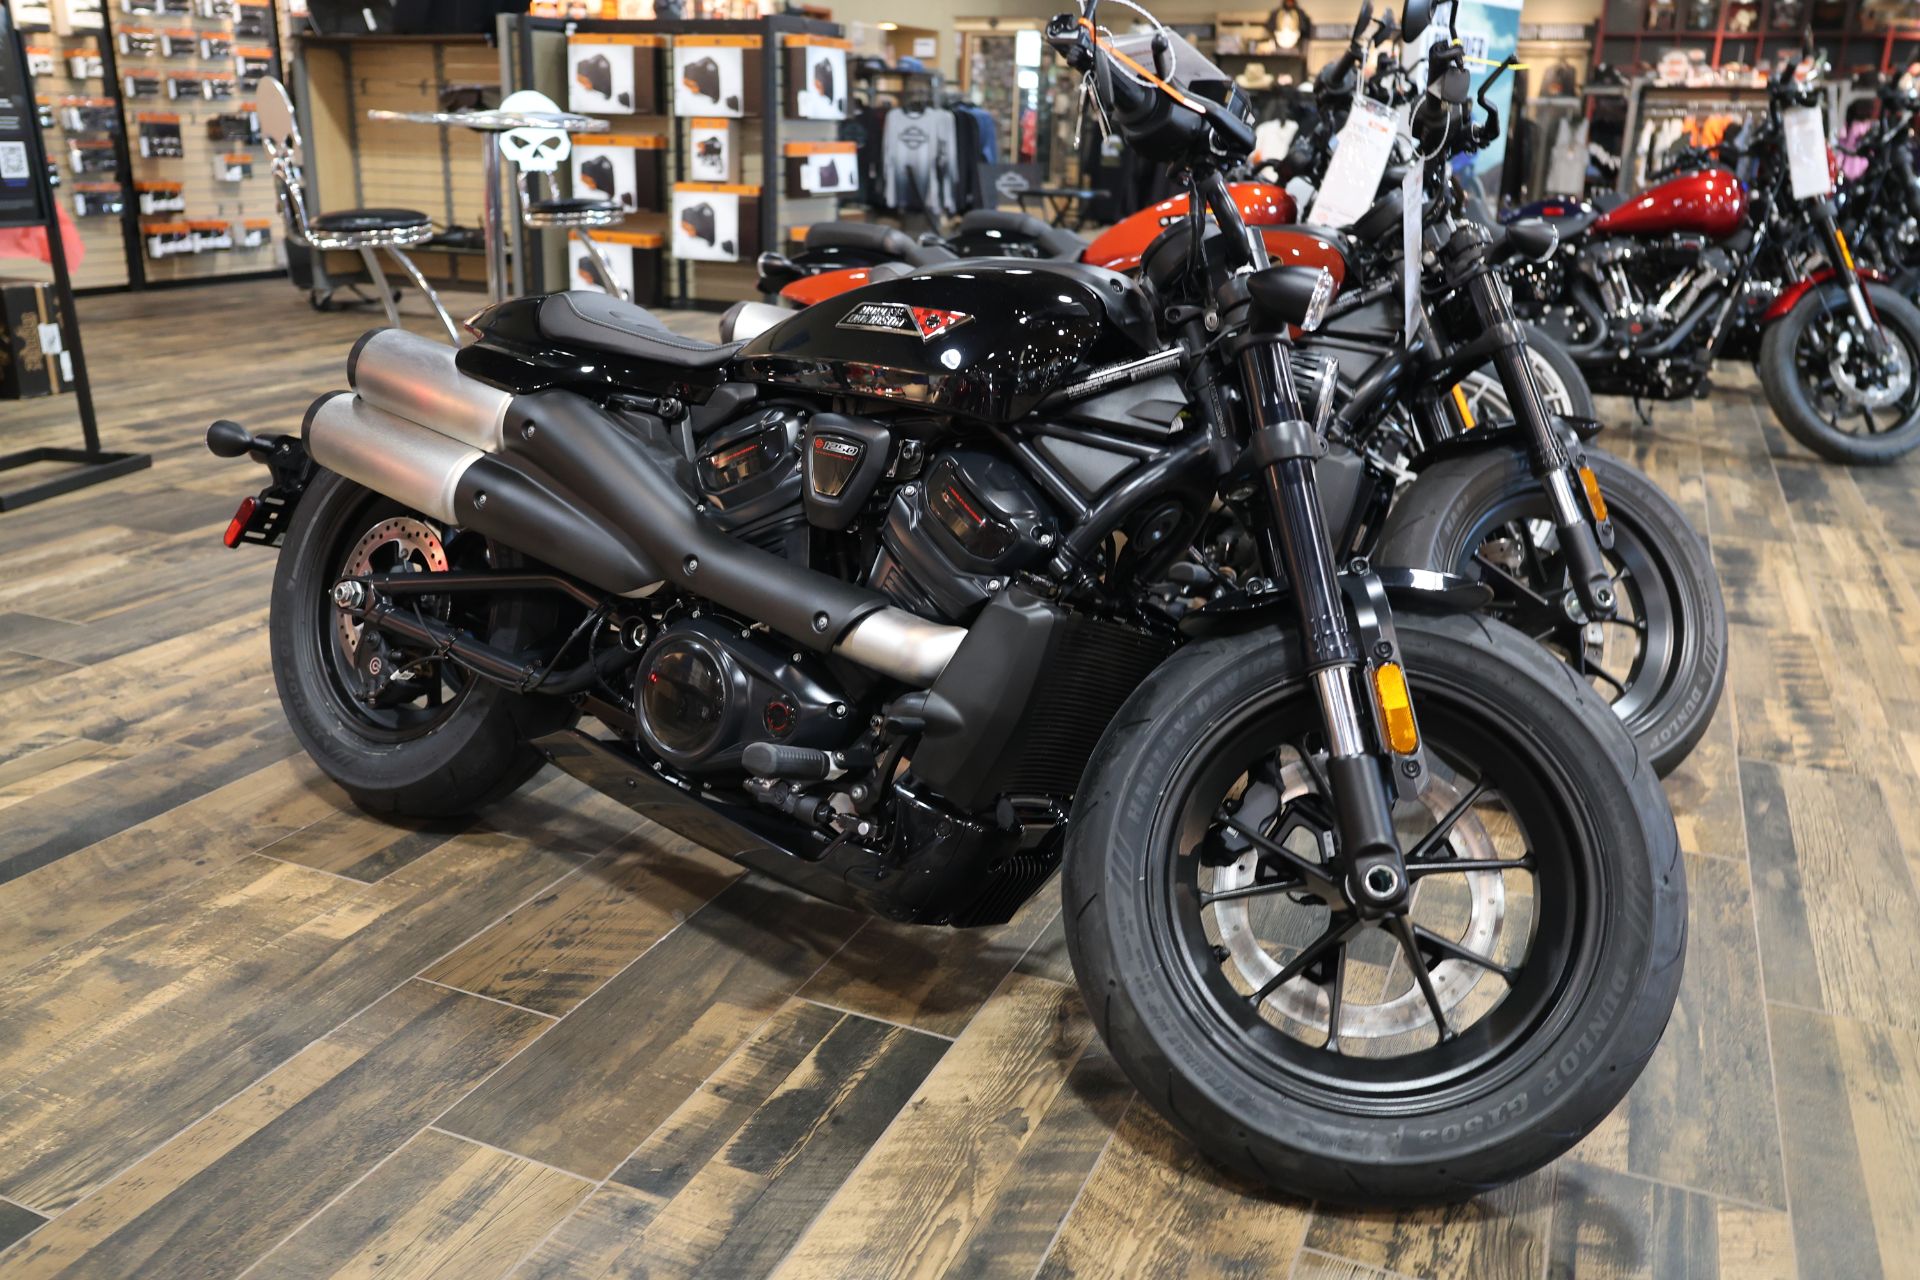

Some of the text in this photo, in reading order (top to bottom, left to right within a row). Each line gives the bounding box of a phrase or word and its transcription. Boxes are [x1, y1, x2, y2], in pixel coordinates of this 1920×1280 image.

[1127, 647, 1287, 825] HARLEY-DAVIDS
[1650, 686, 1702, 749] DUNLOP
[1542, 967, 1630, 1098] DUNLOP
